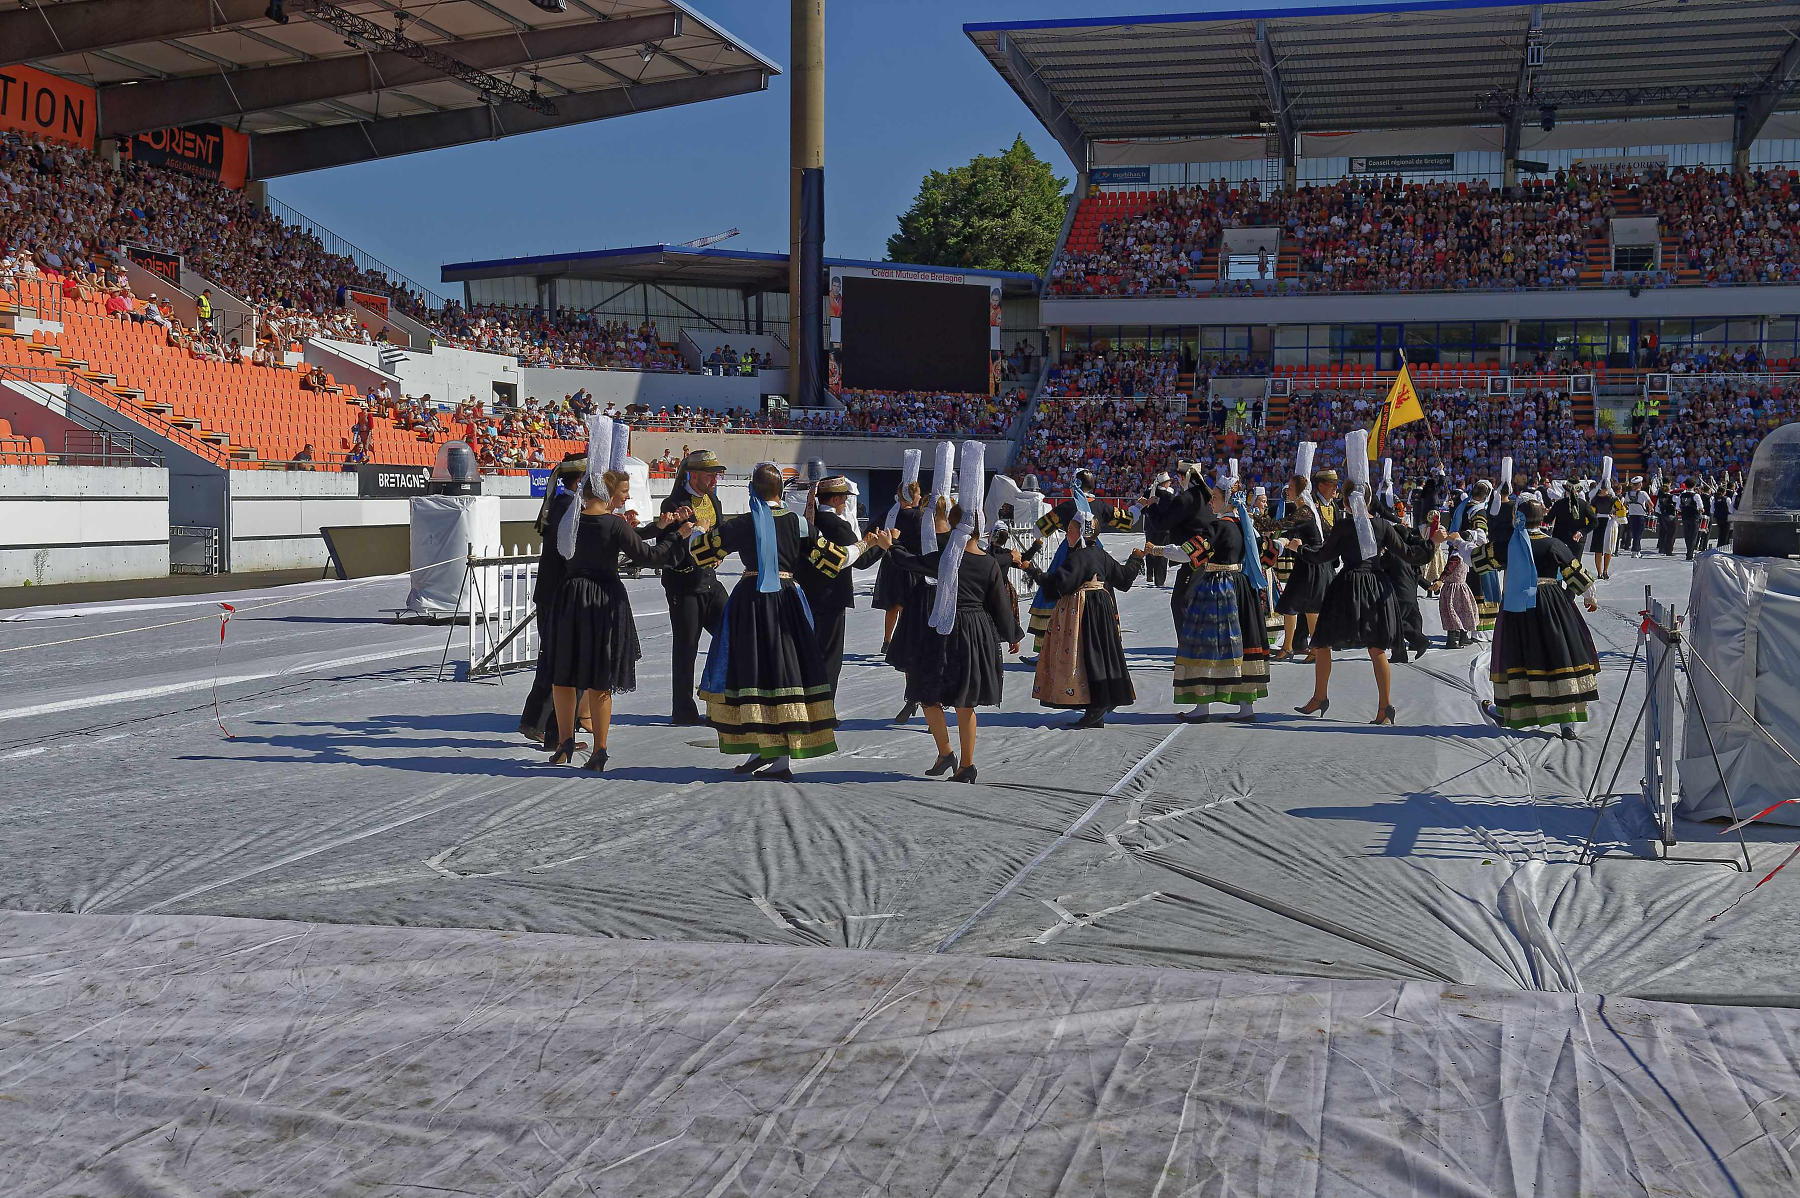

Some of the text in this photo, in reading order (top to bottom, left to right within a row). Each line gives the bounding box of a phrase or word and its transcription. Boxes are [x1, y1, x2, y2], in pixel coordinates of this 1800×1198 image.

[896, 270, 919, 279] Mutuel
[921, 272, 930, 280] de
[931, 272, 963, 284] Bretagne
[378, 473, 425, 488] BRETAGNE
